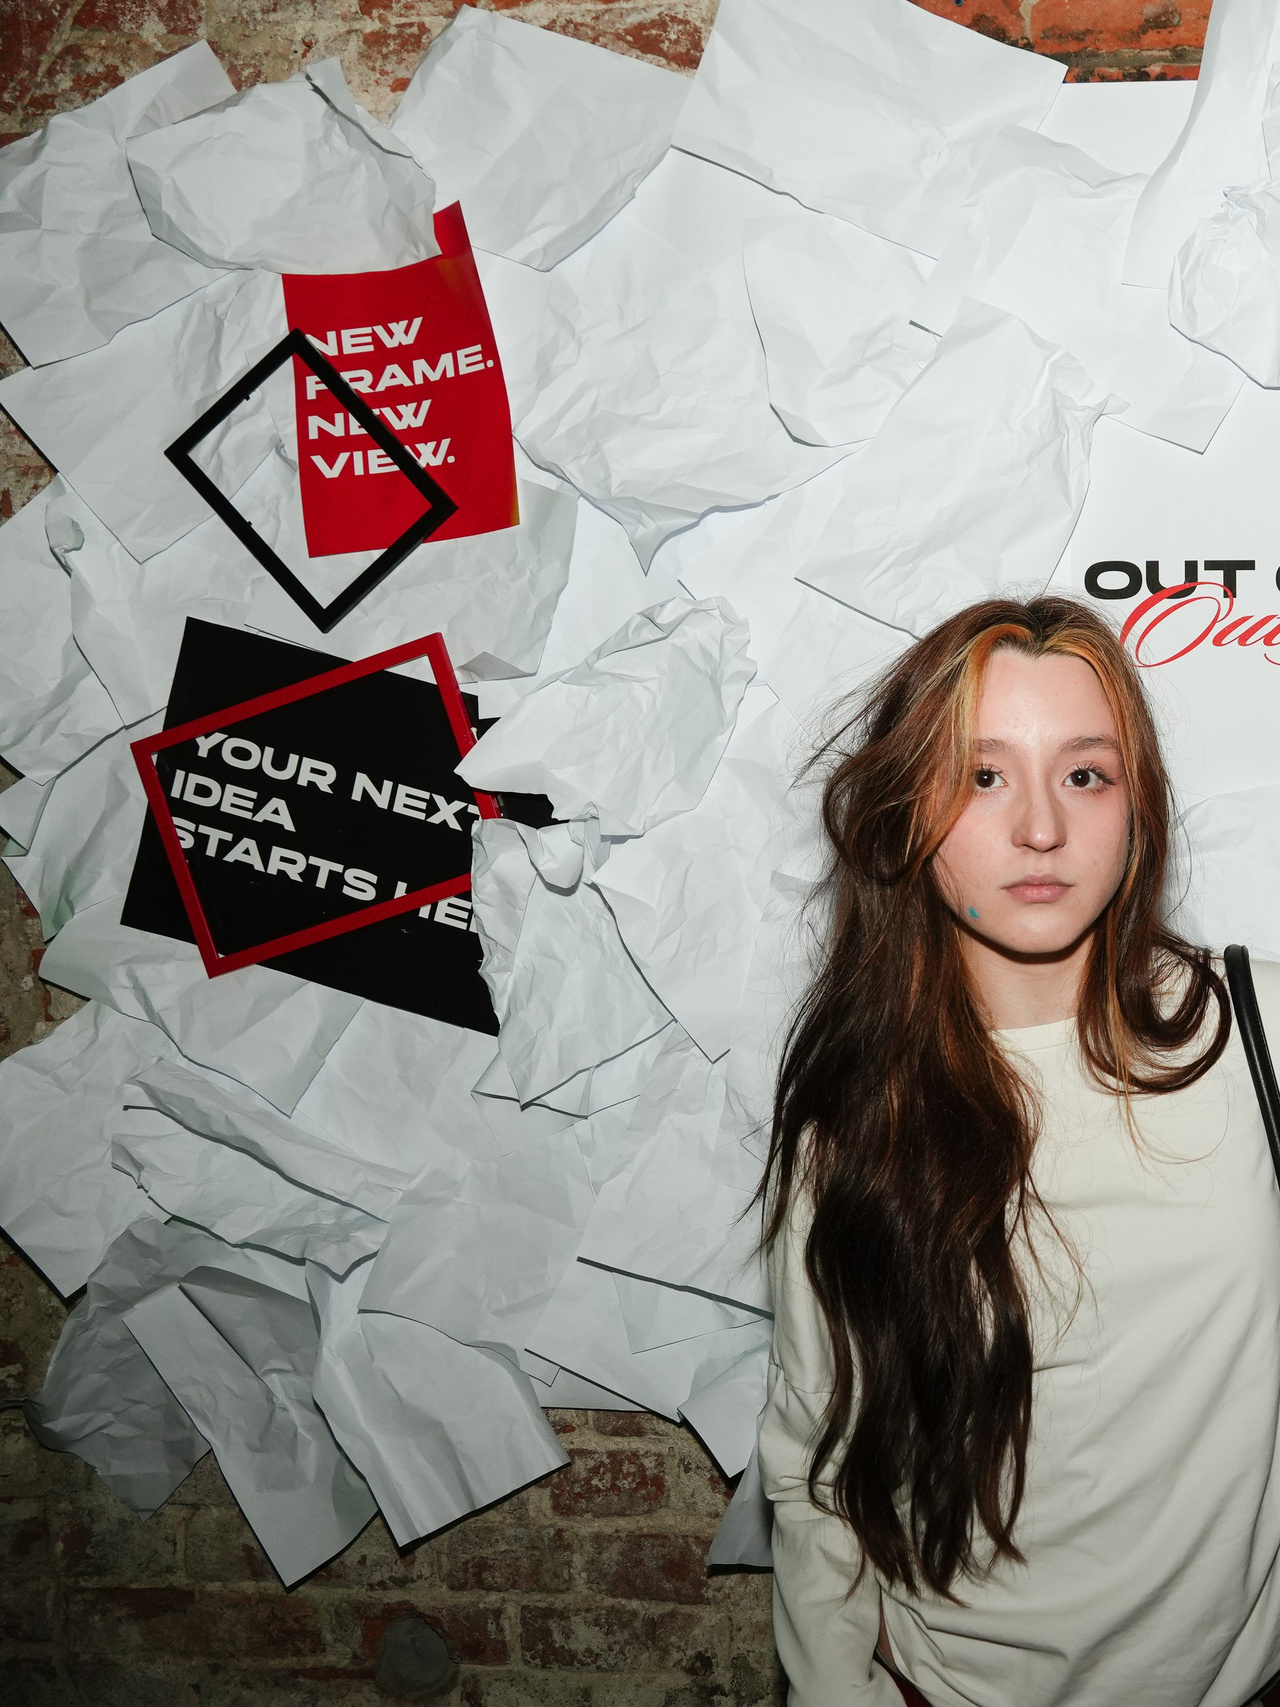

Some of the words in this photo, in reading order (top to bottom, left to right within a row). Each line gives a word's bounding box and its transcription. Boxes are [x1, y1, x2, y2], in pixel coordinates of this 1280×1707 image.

[304, 316, 423, 357] NEW
[305, 344, 494, 400] FRAME.
[310, 438, 456, 479] VIEW.
[1084, 560, 1255, 600] OUT
[195, 732, 337, 794] YOUR
[170, 769, 296, 833] IDEA
[171, 816, 378, 901] STARTS
